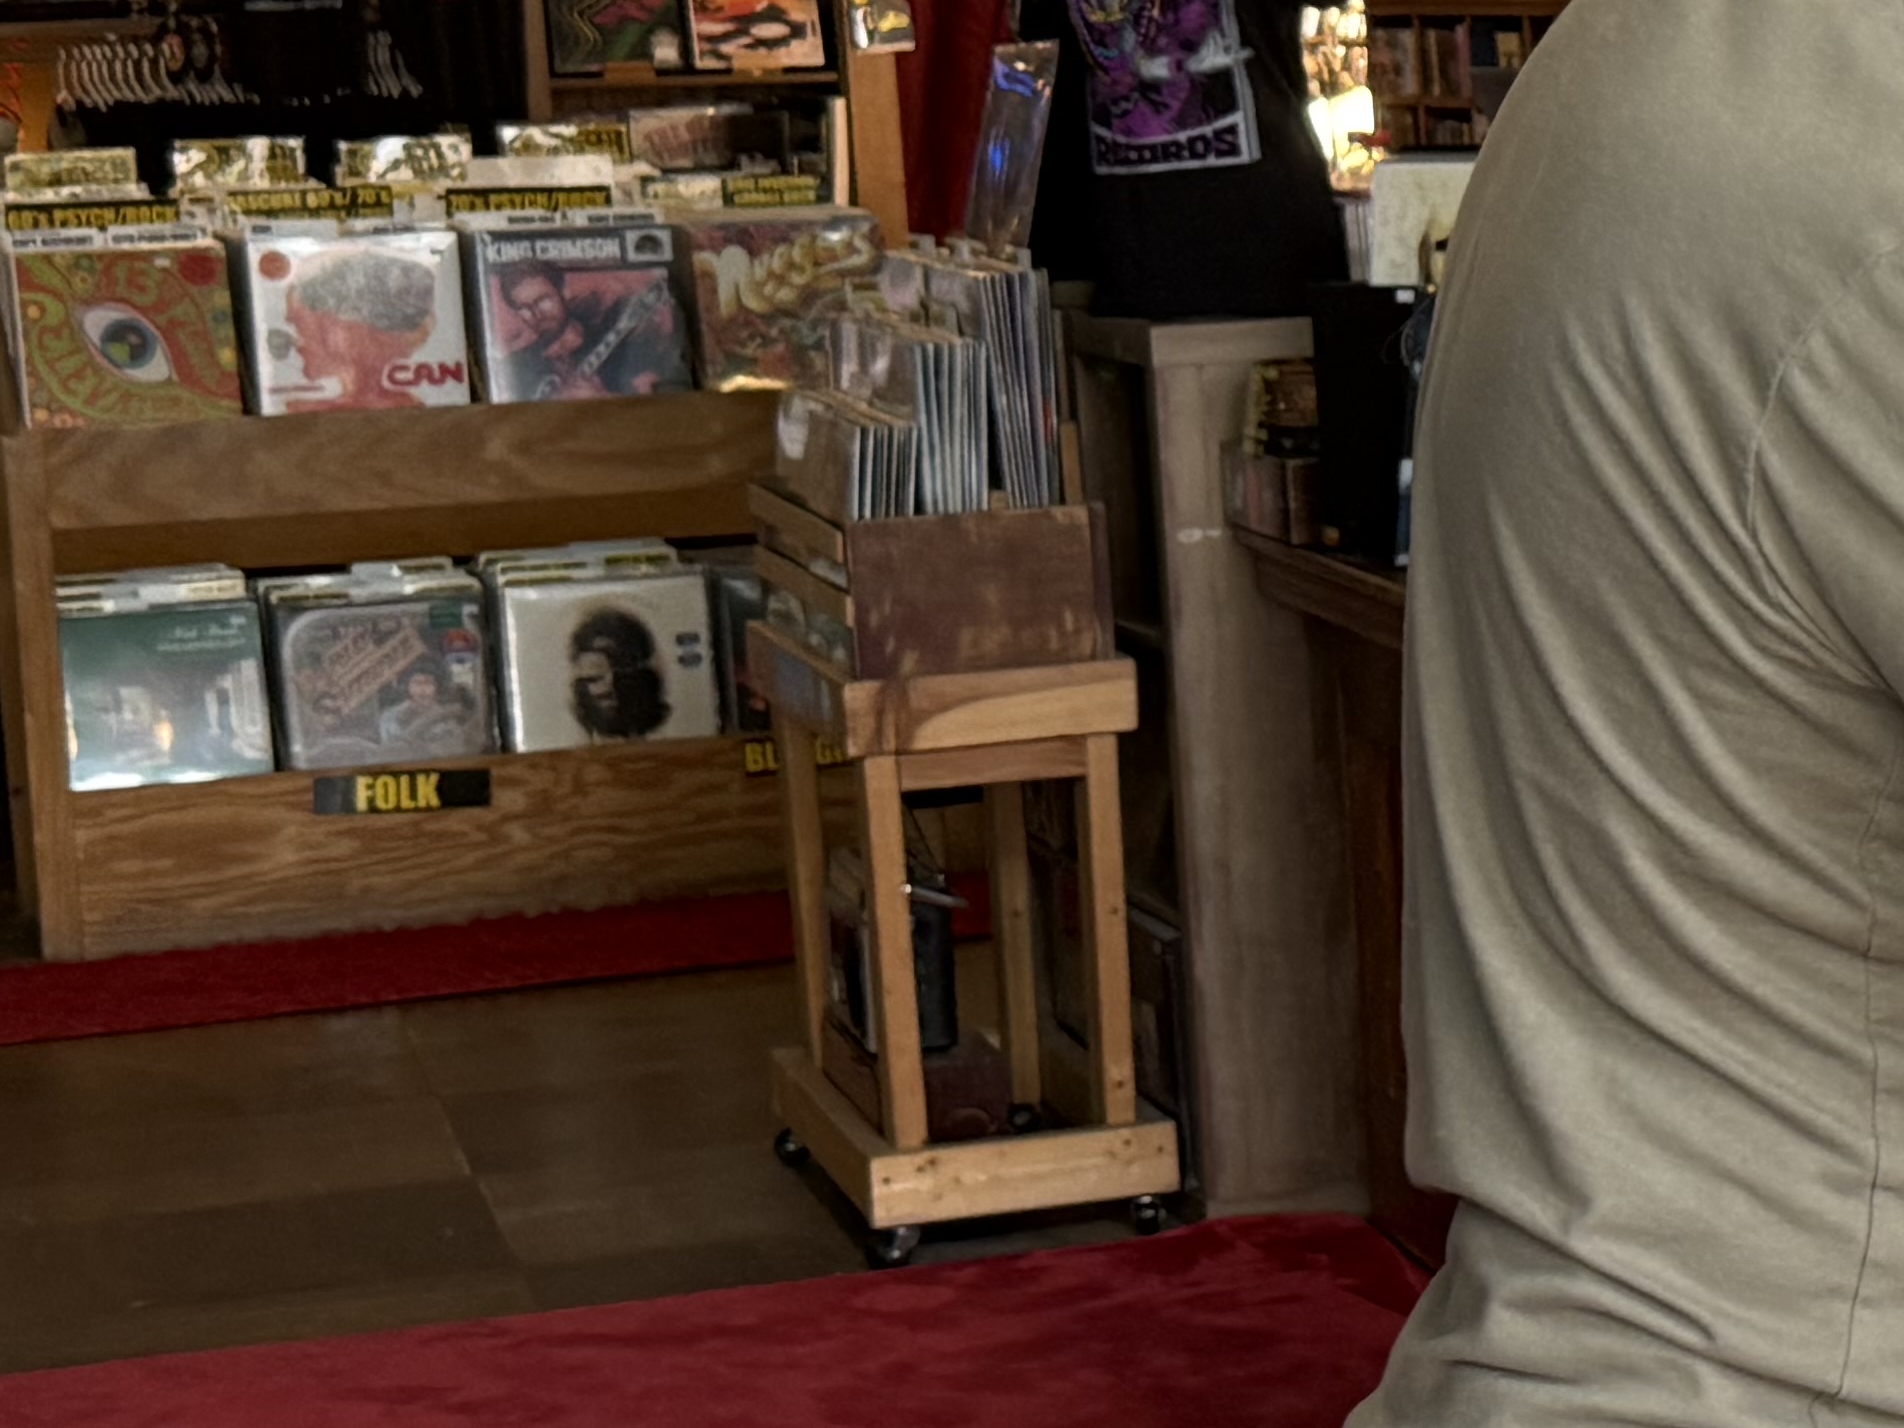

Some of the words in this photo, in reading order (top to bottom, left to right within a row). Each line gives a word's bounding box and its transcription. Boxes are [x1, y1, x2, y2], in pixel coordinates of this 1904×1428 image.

[485, 239, 533, 264] KING
[535, 236, 622, 262] CRIMSON
[384, 360, 466, 390] CAN
[353, 772, 442, 814] FOLK
